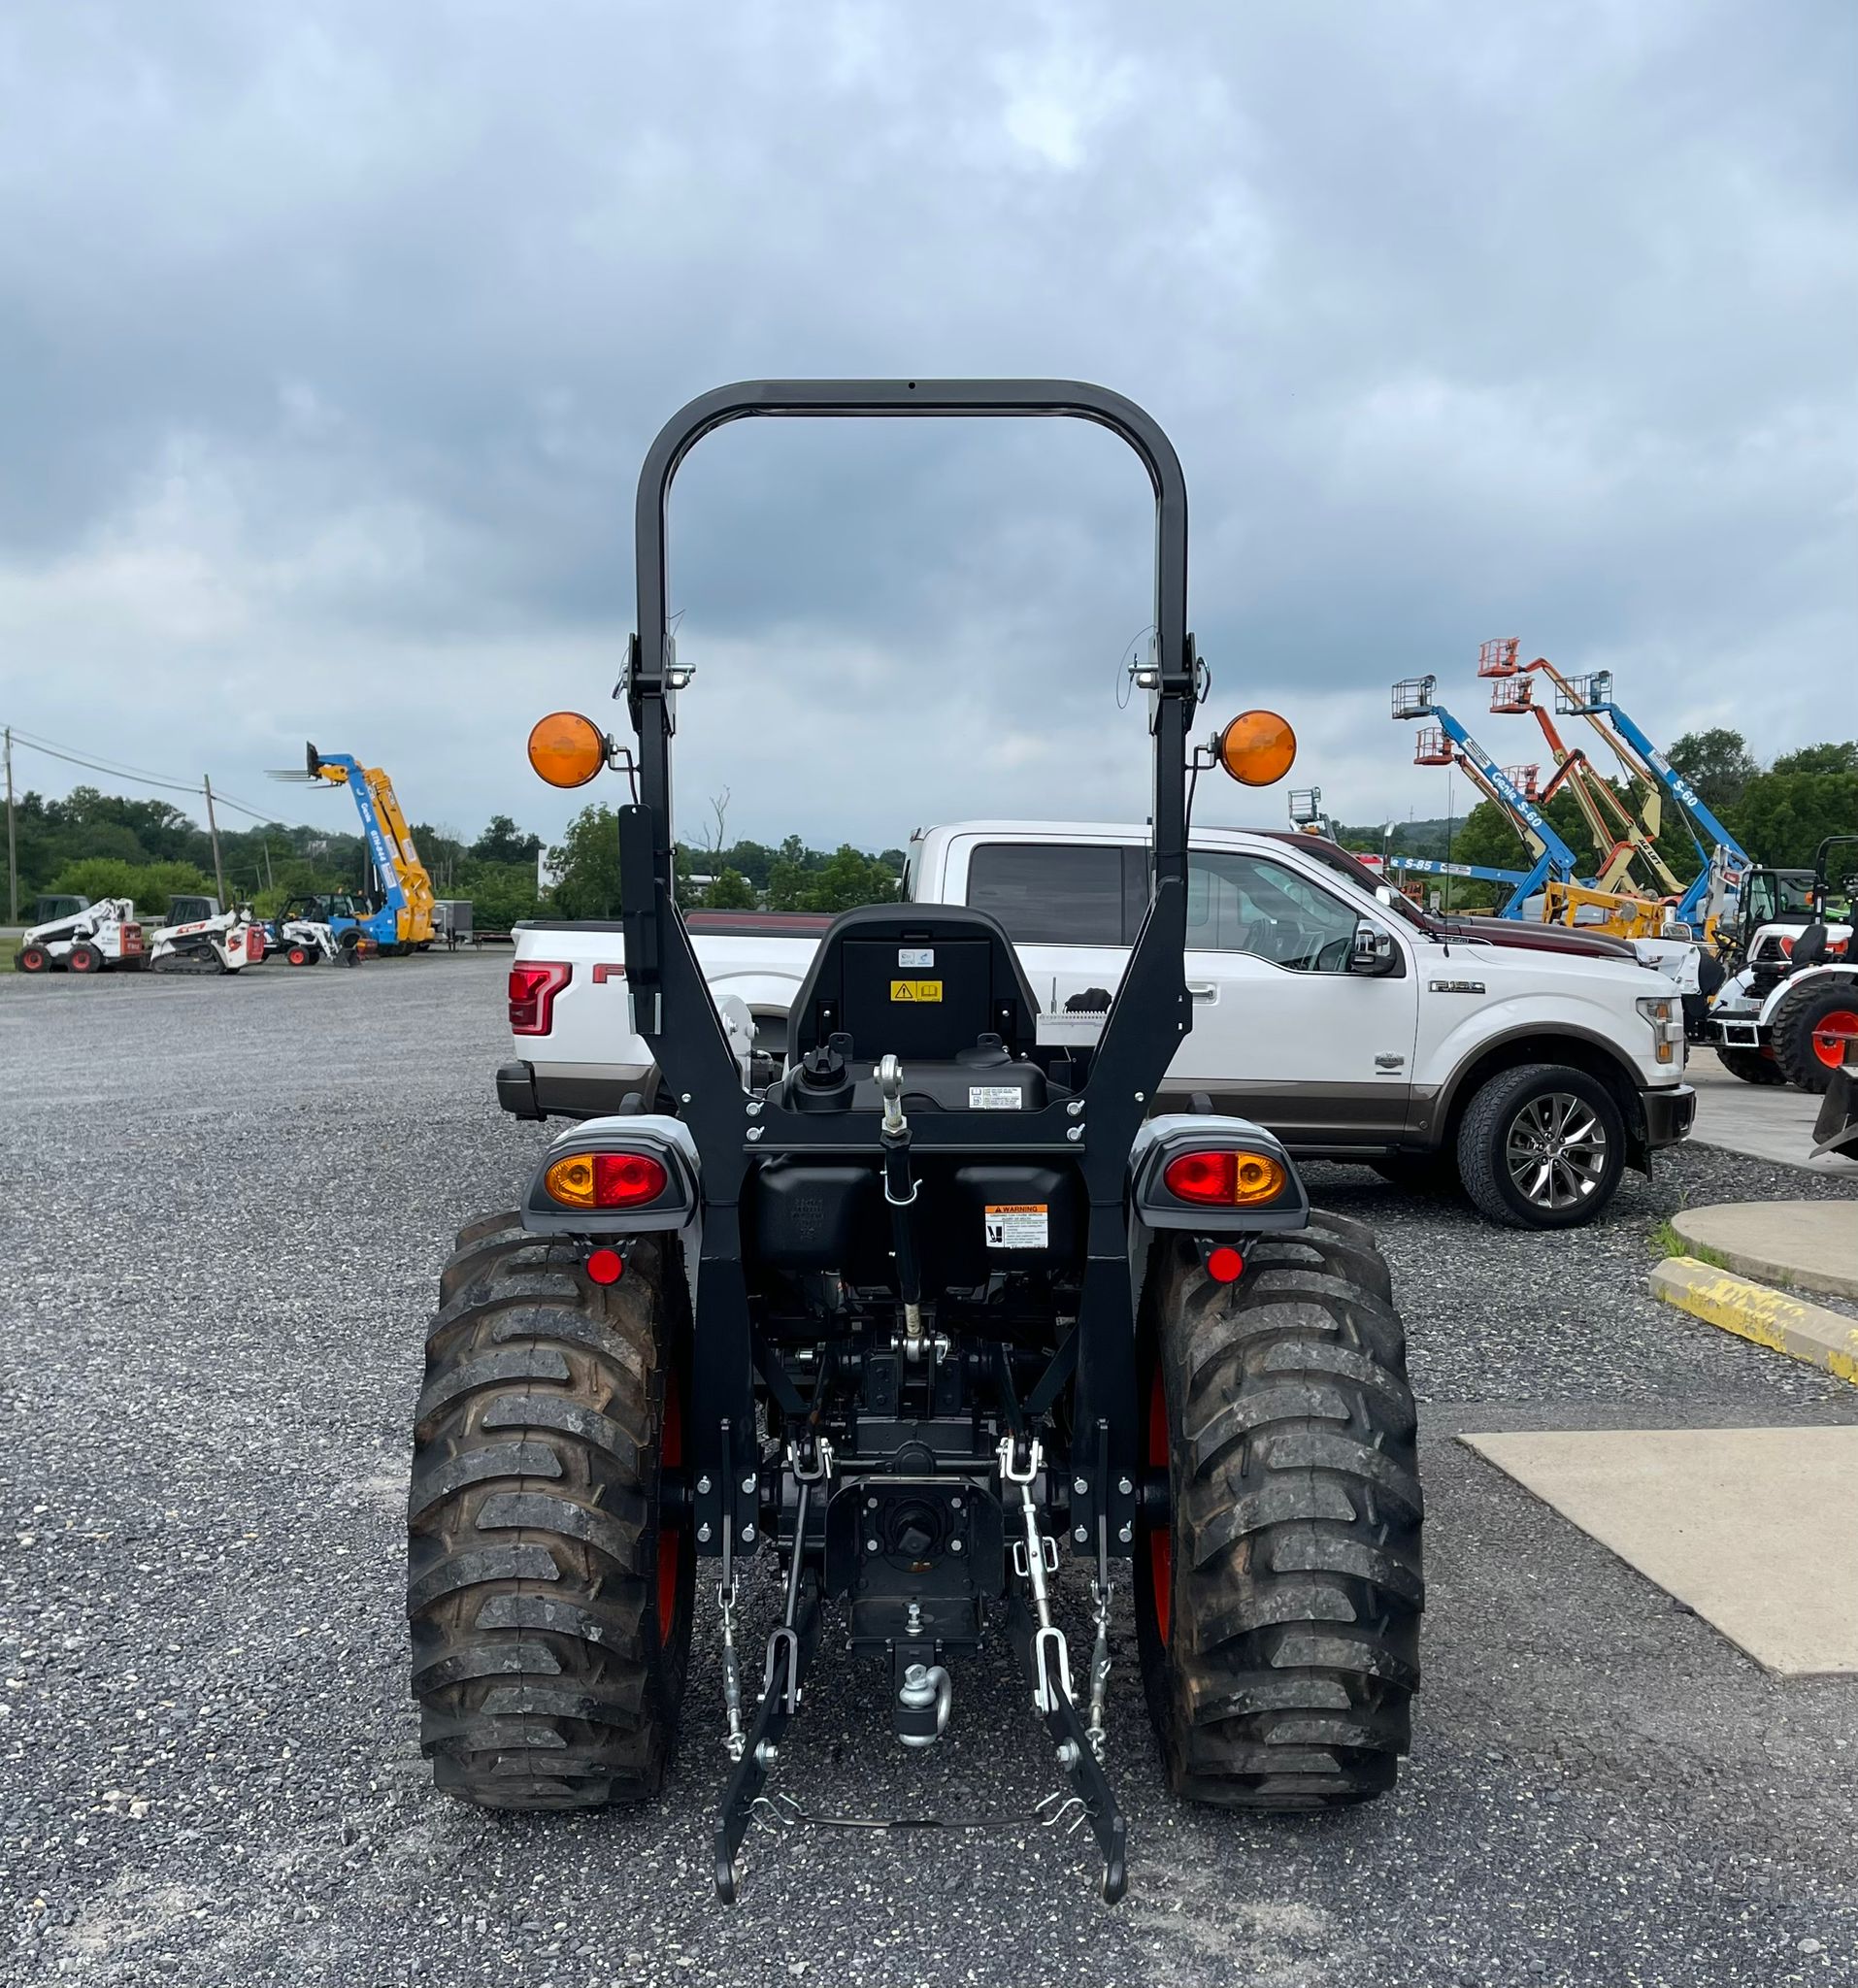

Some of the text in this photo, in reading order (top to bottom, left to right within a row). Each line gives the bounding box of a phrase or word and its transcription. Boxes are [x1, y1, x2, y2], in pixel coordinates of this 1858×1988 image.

[1492, 772, 1543, 827] Genie S-60
[1673, 779, 1699, 807] S-60
[360, 802, 386, 861] Genie GTH-844
[1405, 858, 1433, 871] S-85
[1638, 839, 1662, 865] JLG LIFT
